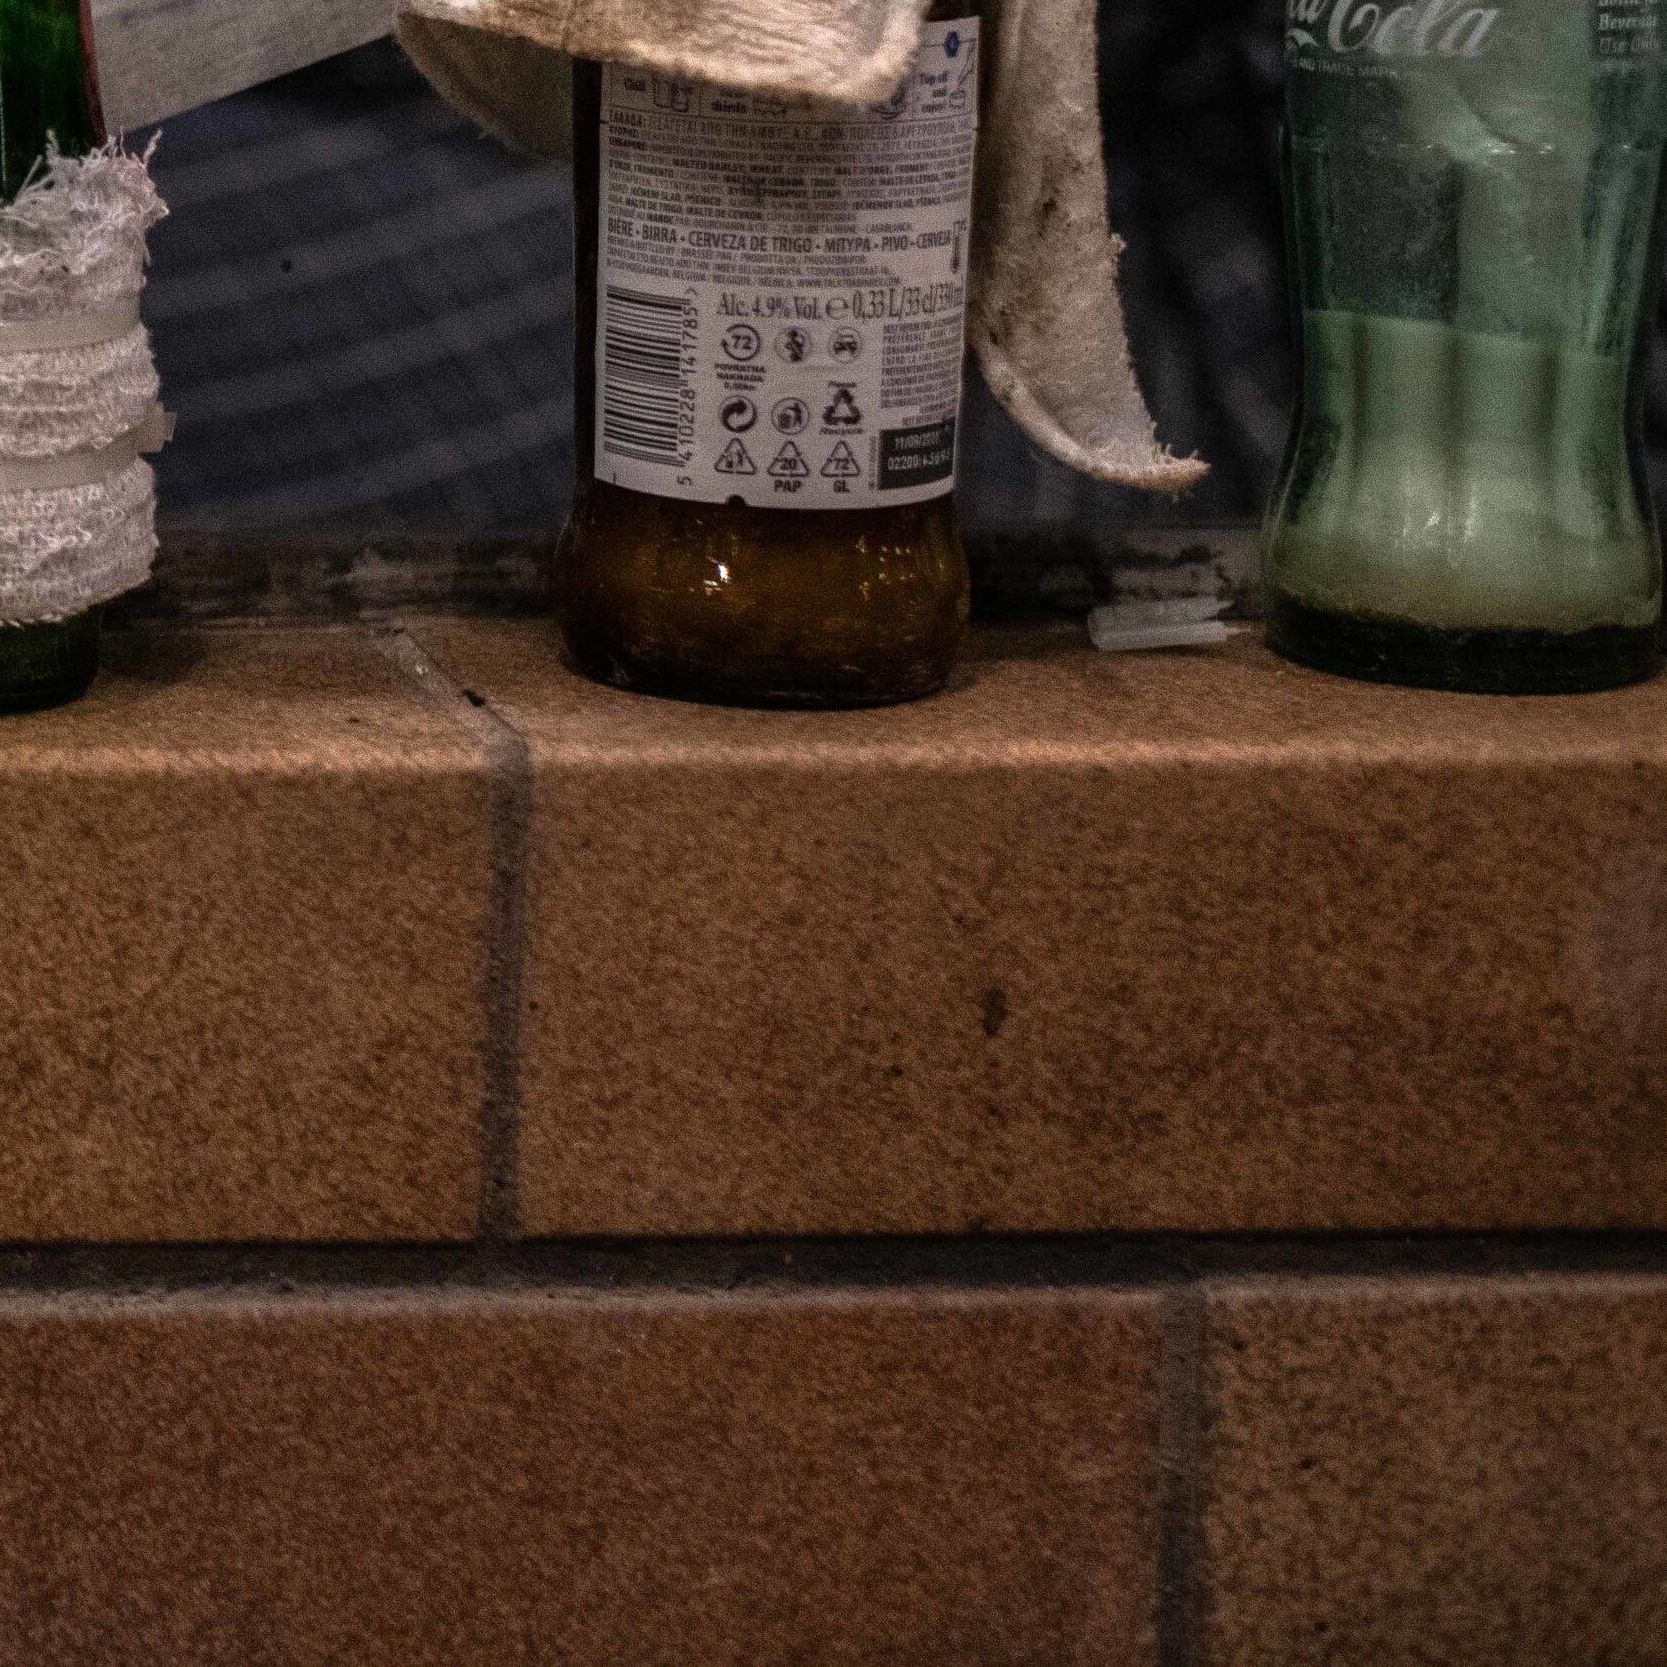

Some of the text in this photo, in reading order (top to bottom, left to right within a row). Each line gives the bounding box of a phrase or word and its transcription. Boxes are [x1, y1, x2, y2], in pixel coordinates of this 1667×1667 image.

[641, 223, 678, 245] BIRRA
[688, 229, 747, 252] CERVEZA
[750, 234, 768, 251] DE
[771, 235, 813, 253] TRIGO
[880, 235, 909, 253] PIVO
[716, 291, 749, 317] Alc.
[751, 295, 791, 320] 4.9%
[793, 295, 823, 321] Vol.
[731, 335, 753, 351] 72
[676, 305, 700, 487] 5 410228 141785
[774, 478, 803, 494] PAP
